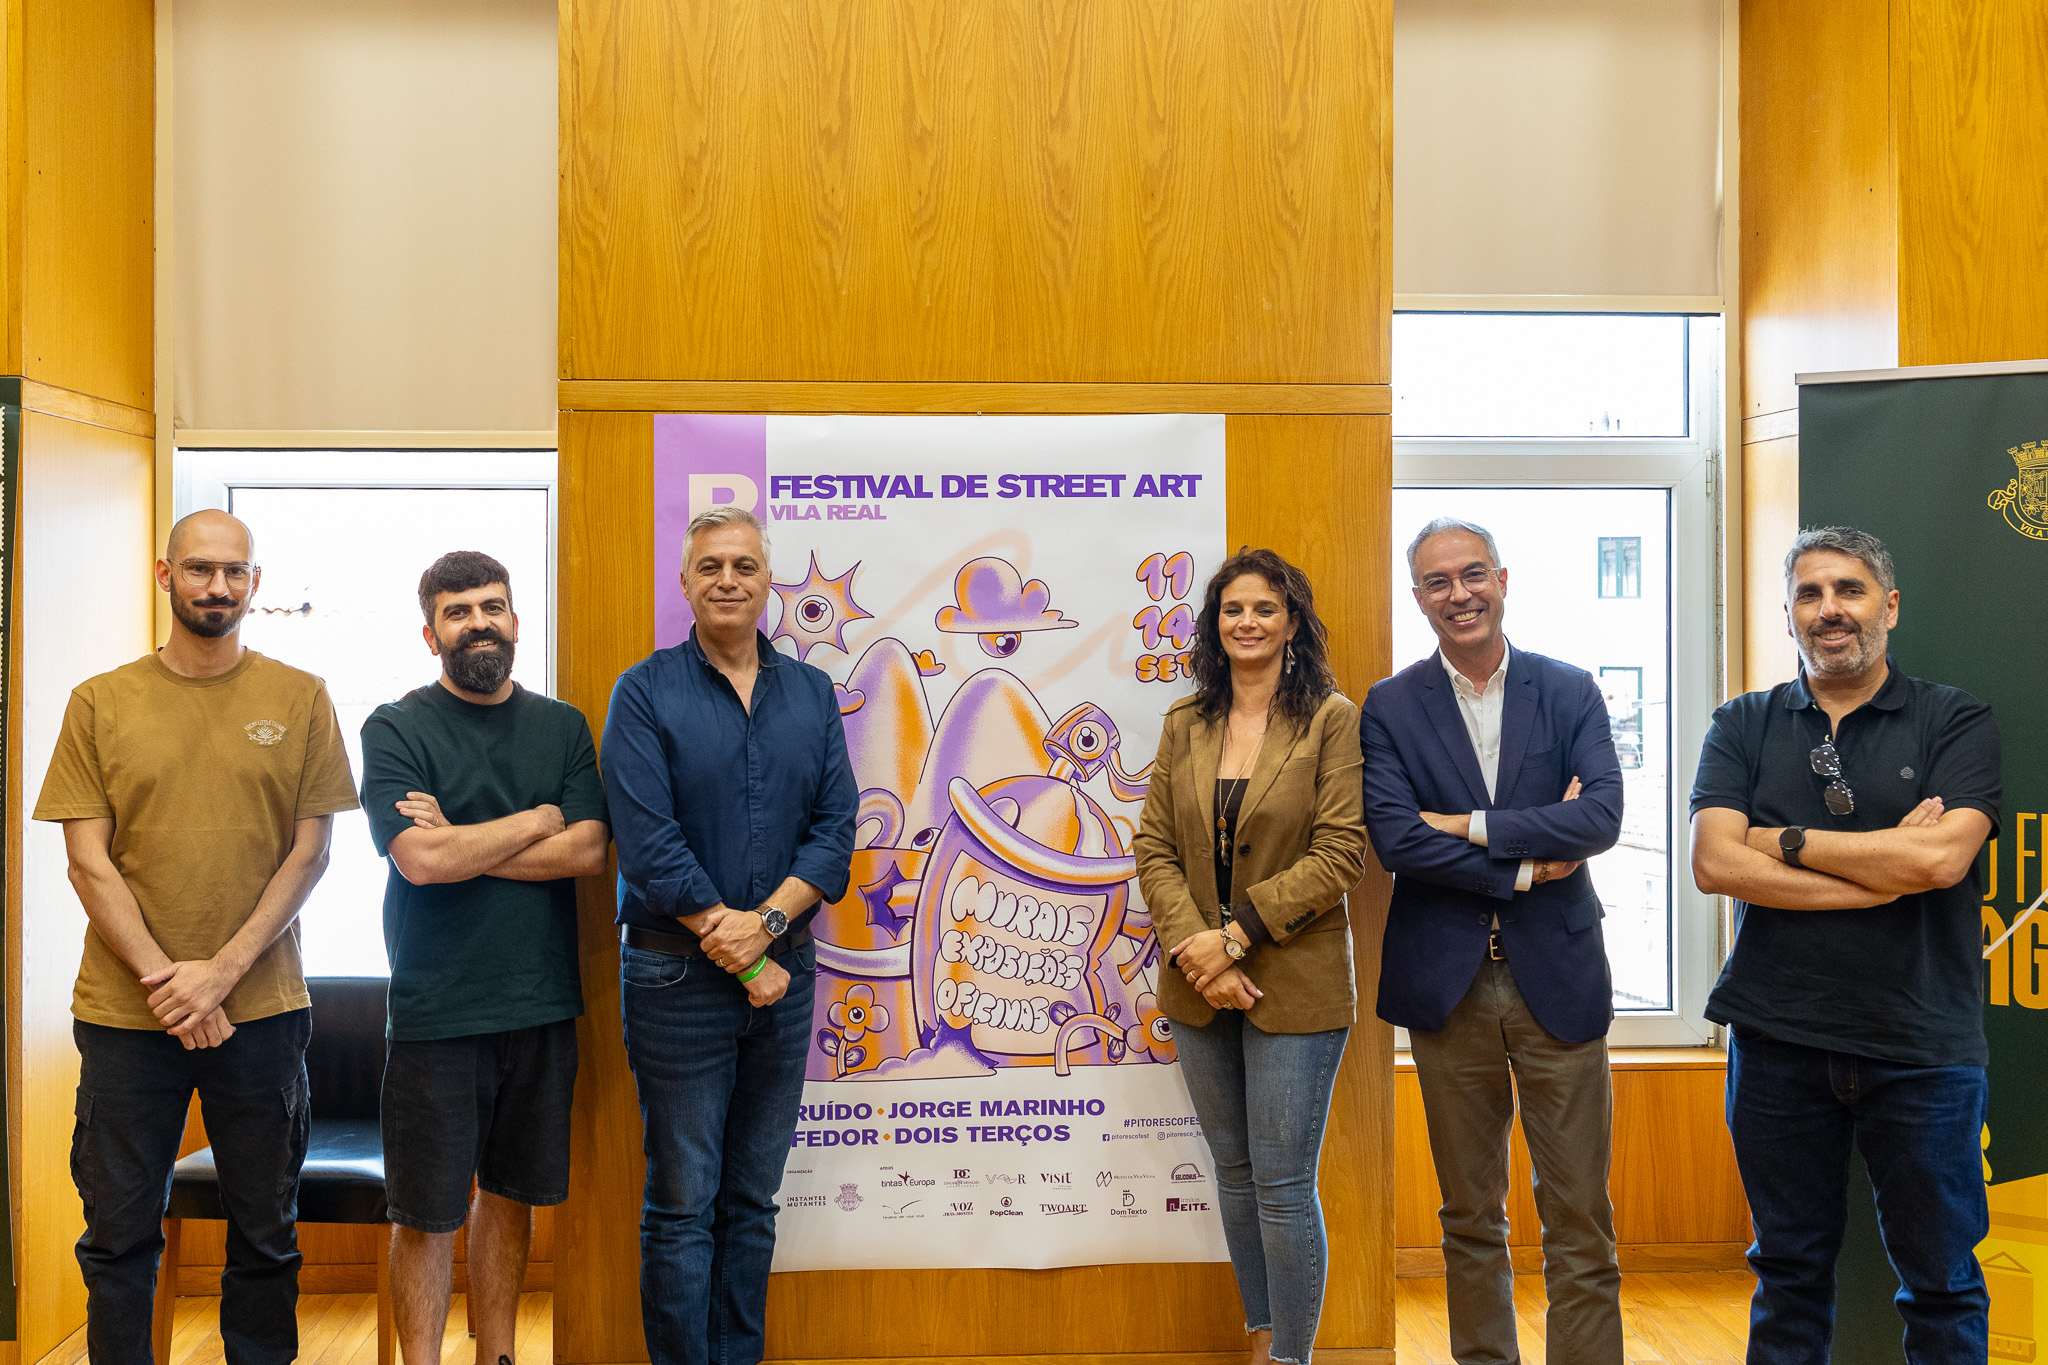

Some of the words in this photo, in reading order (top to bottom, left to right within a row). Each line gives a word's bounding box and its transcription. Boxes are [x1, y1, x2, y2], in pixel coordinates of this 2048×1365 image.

[770, 474, 933, 499] FESTIVAL
[941, 475, 988, 498] DE
[996, 473, 1126, 499] STREET
[1133, 474, 1202, 498] ART
[770, 504, 821, 521] VILA
[827, 504, 887, 521] REAL
[2020, 522, 2043, 538] VILA
[1136, 551, 1194, 602] 11
[1133, 603, 1198, 650] 14
[1136, 651, 1194, 683] SET
[950, 875, 1095, 946] MURAIS
[798, 1100, 872, 1122] RUÍDO
[888, 1101, 972, 1119] JORGE
[980, 1098, 1106, 1117] MARINHO
[1124, 1116, 1200, 1128] #PITORESCOFES
[792, 1128, 879, 1148] FEDOR
[895, 1126, 958, 1145] DOIS
[966, 1124, 1071, 1147] TERÇOS
[1111, 1133, 1149, 1141] pitorescofest
[909, 1179, 936, 1187] Europa
[989, 1209, 1024, 1217] PopClean
[1039, 1203, 1087, 1213] TWOART
[1128, 1207, 1148, 1215] Texto
